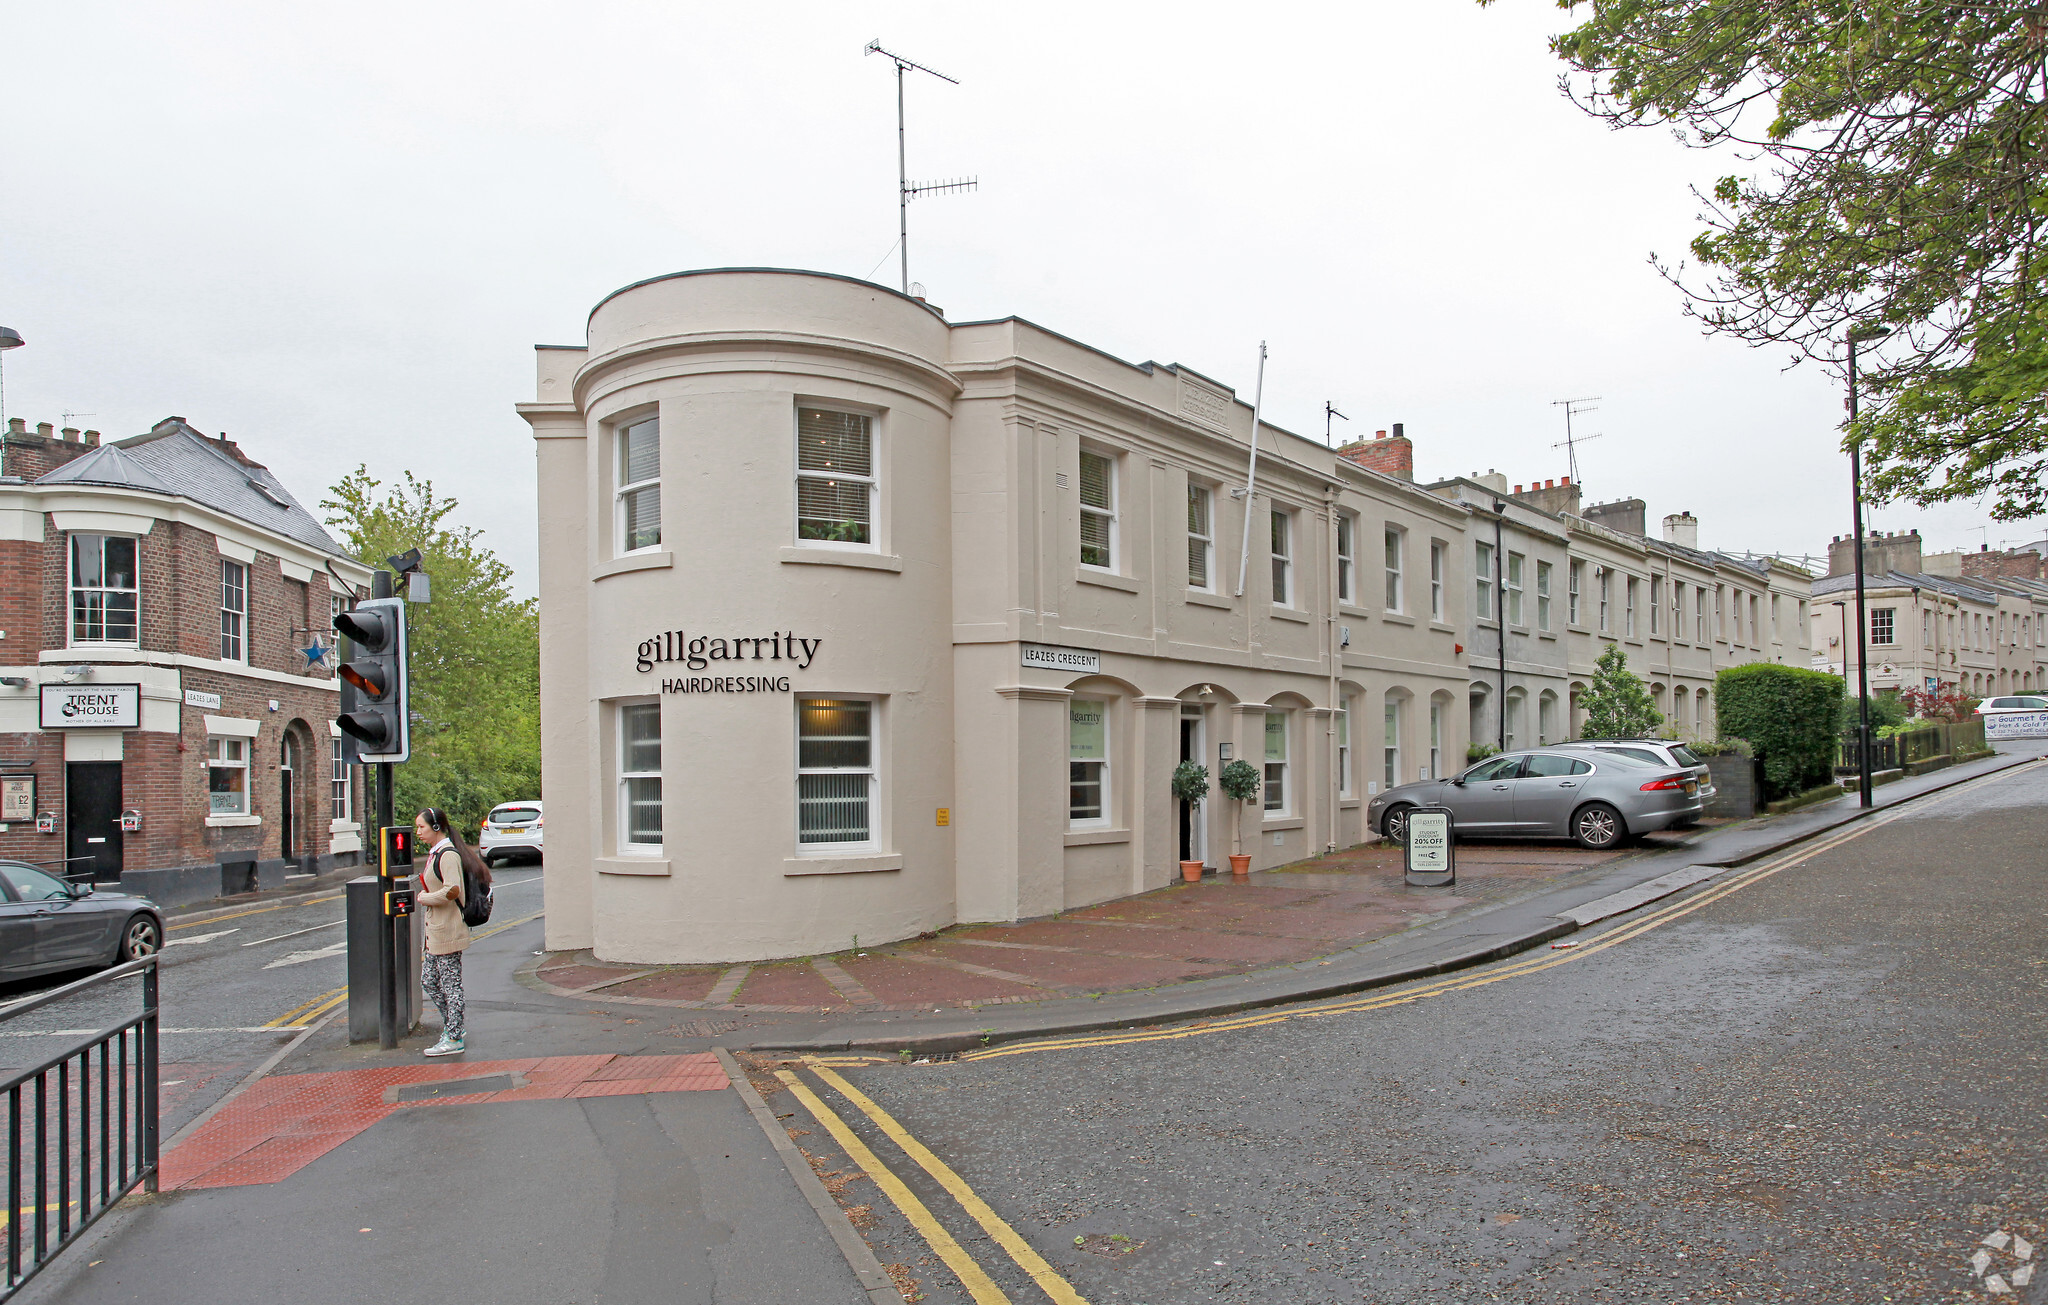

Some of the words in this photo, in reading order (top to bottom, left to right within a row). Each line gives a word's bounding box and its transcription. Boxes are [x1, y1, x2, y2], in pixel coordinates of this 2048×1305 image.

[636, 630, 822, 673] gillgarrity
[1025, 649, 1055, 663] LEAZES
[1057, 653, 1096, 667] CRESCENT
[661, 676, 790, 694] HAIRDRESSING
[68, 694, 118, 706] TRENT
[187, 693, 205, 703] LEAZES
[206, 697, 219, 705] LANE
[77, 706, 119, 715] HOUSE
[1069, 710, 1101, 725] llgarrity
[1998, 715, 2035, 723] Gourmet
[18, 794, 29, 805] £2
